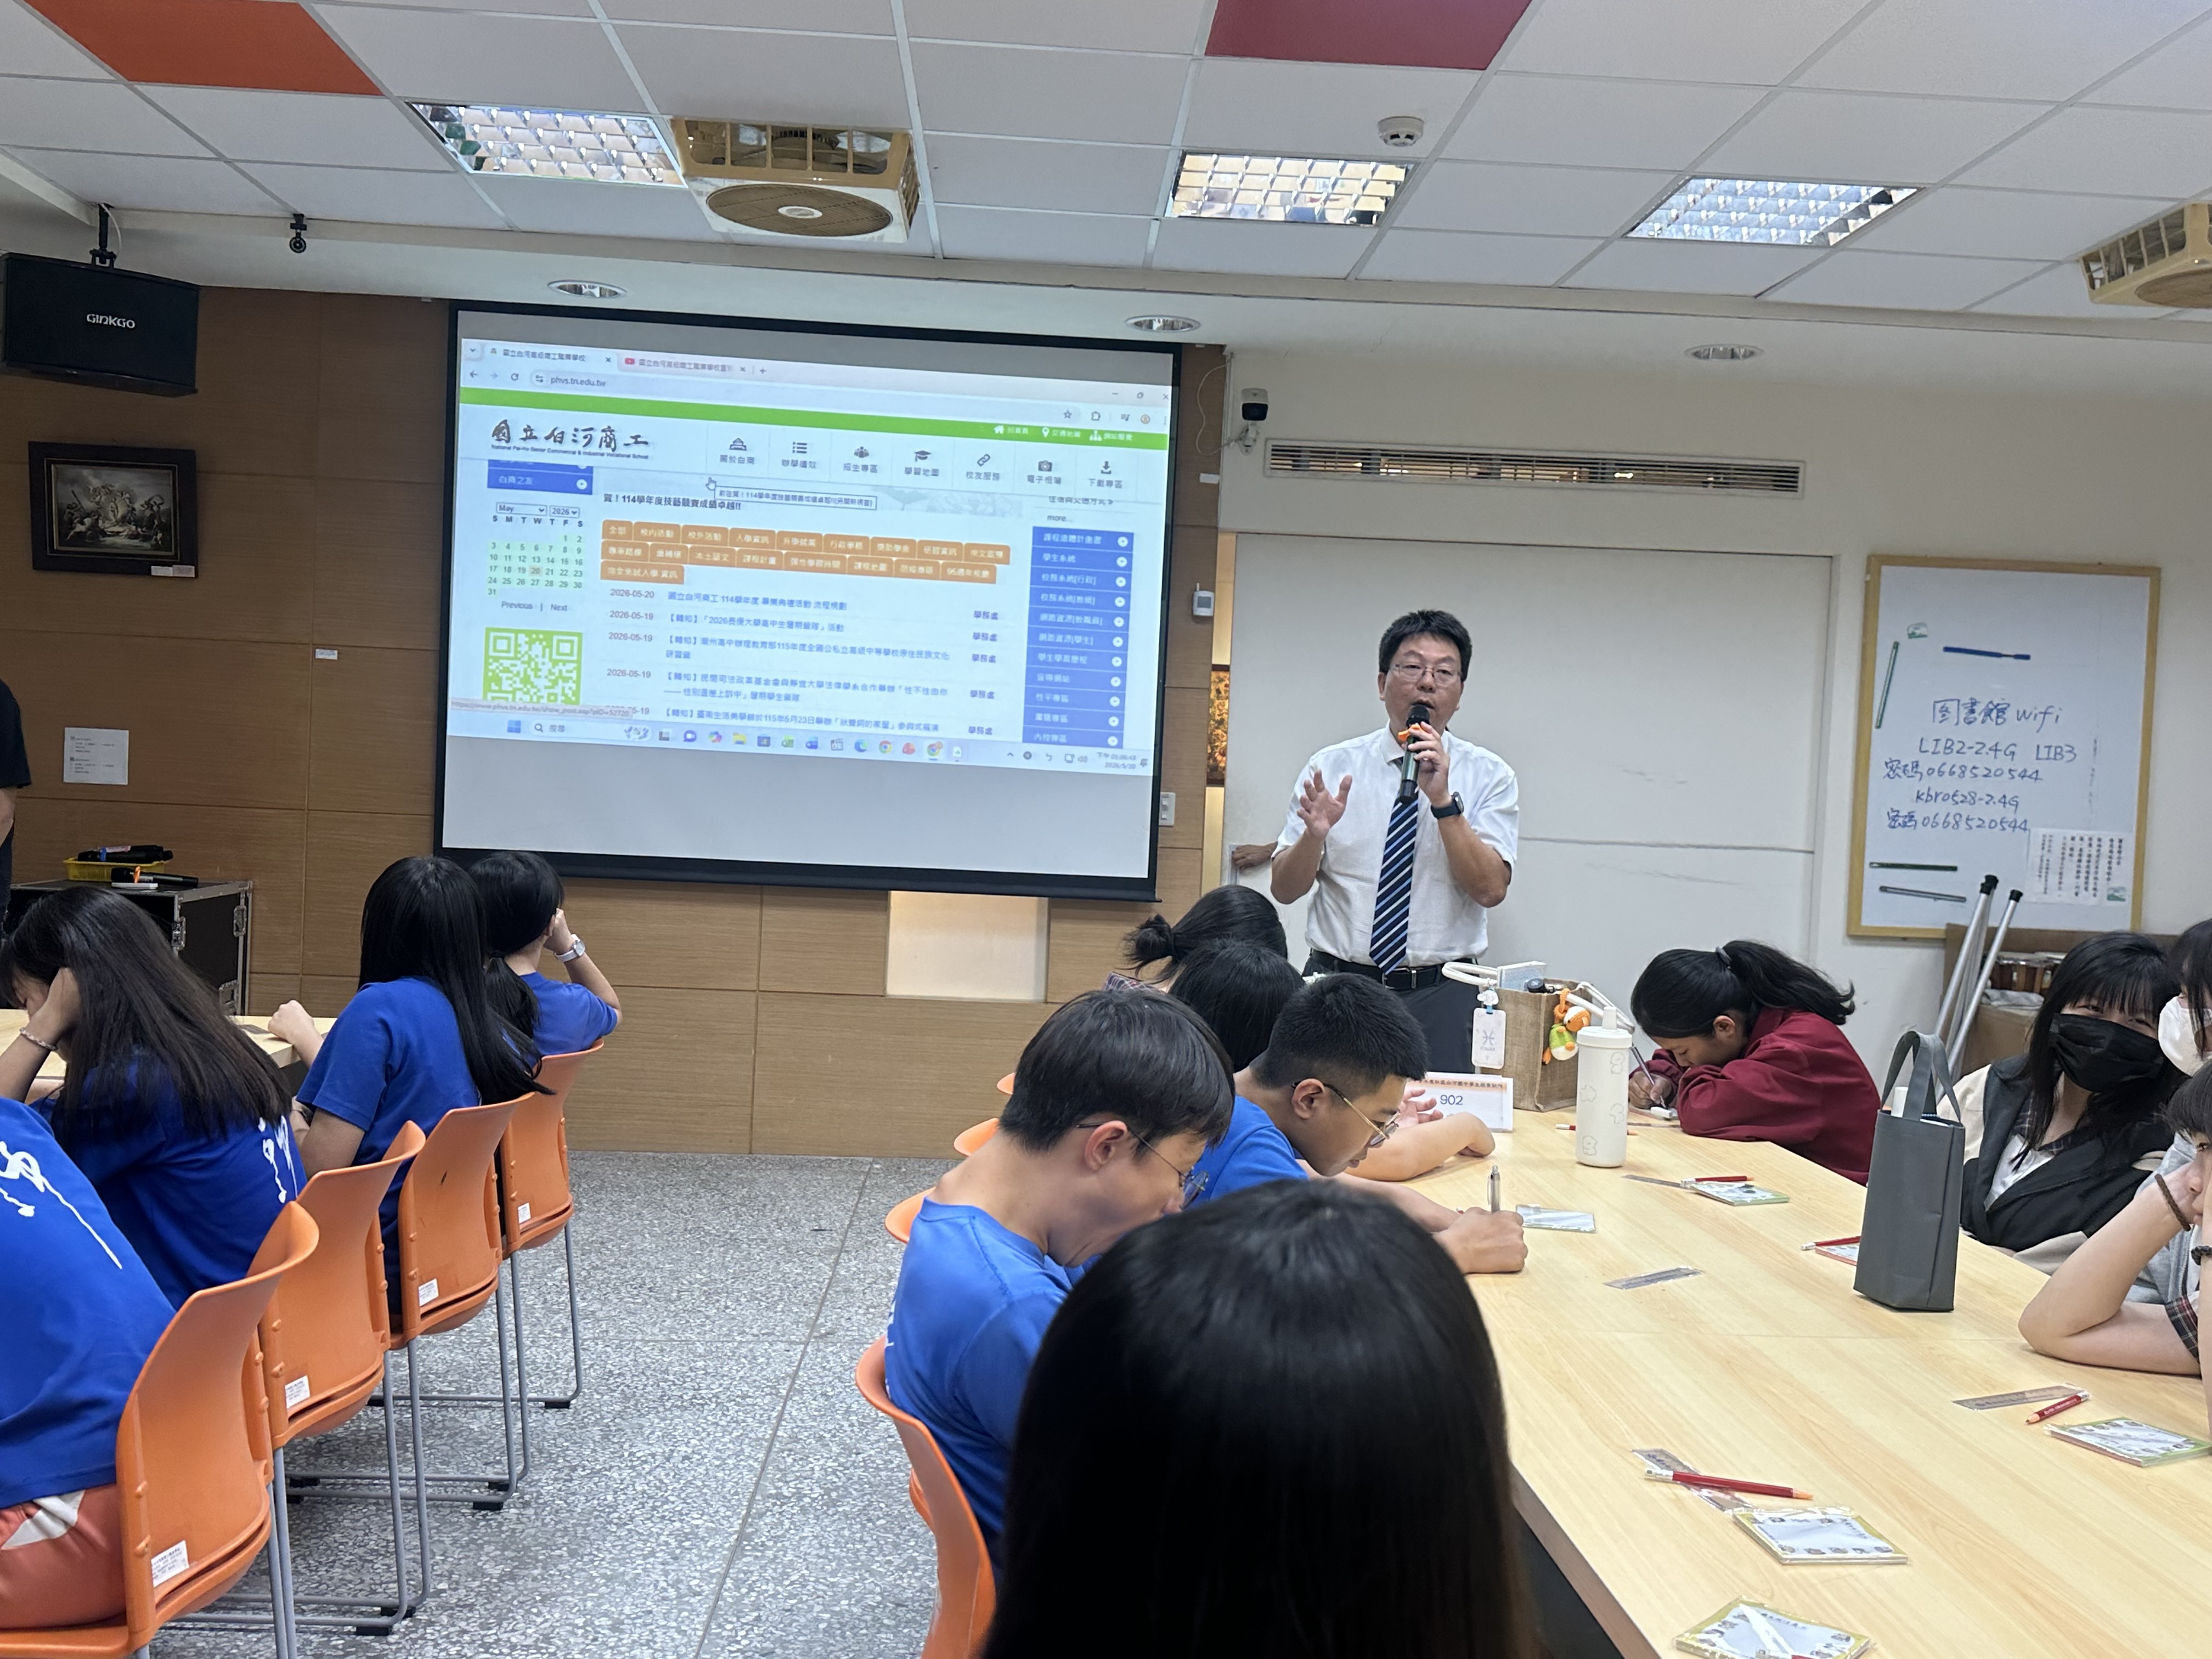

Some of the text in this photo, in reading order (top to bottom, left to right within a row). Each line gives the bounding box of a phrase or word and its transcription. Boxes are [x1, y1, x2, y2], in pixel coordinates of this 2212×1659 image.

[86, 313, 136, 329] GINKGO
[550, 375, 606, 387] phvs.tn.edu.tw
[491, 417, 650, 454] 國立白河商工
[498, 504, 514, 512] May
[610, 588, 654, 598] 2026-05-20
[667, 591, 720, 602] 國立白河商工
[721, 594, 759, 605] 114學年度
[501, 601, 533, 611] Previous
[550, 603, 568, 612] Next
[609, 610, 653, 620] 2026-05-19
[608, 632, 653, 642] 2026-05-19
[607, 668, 651, 679] 2026-05-19
[1918, 737, 2077, 763] LIB2-2.4G LIB3
[1440, 1094, 1464, 1106] 902
